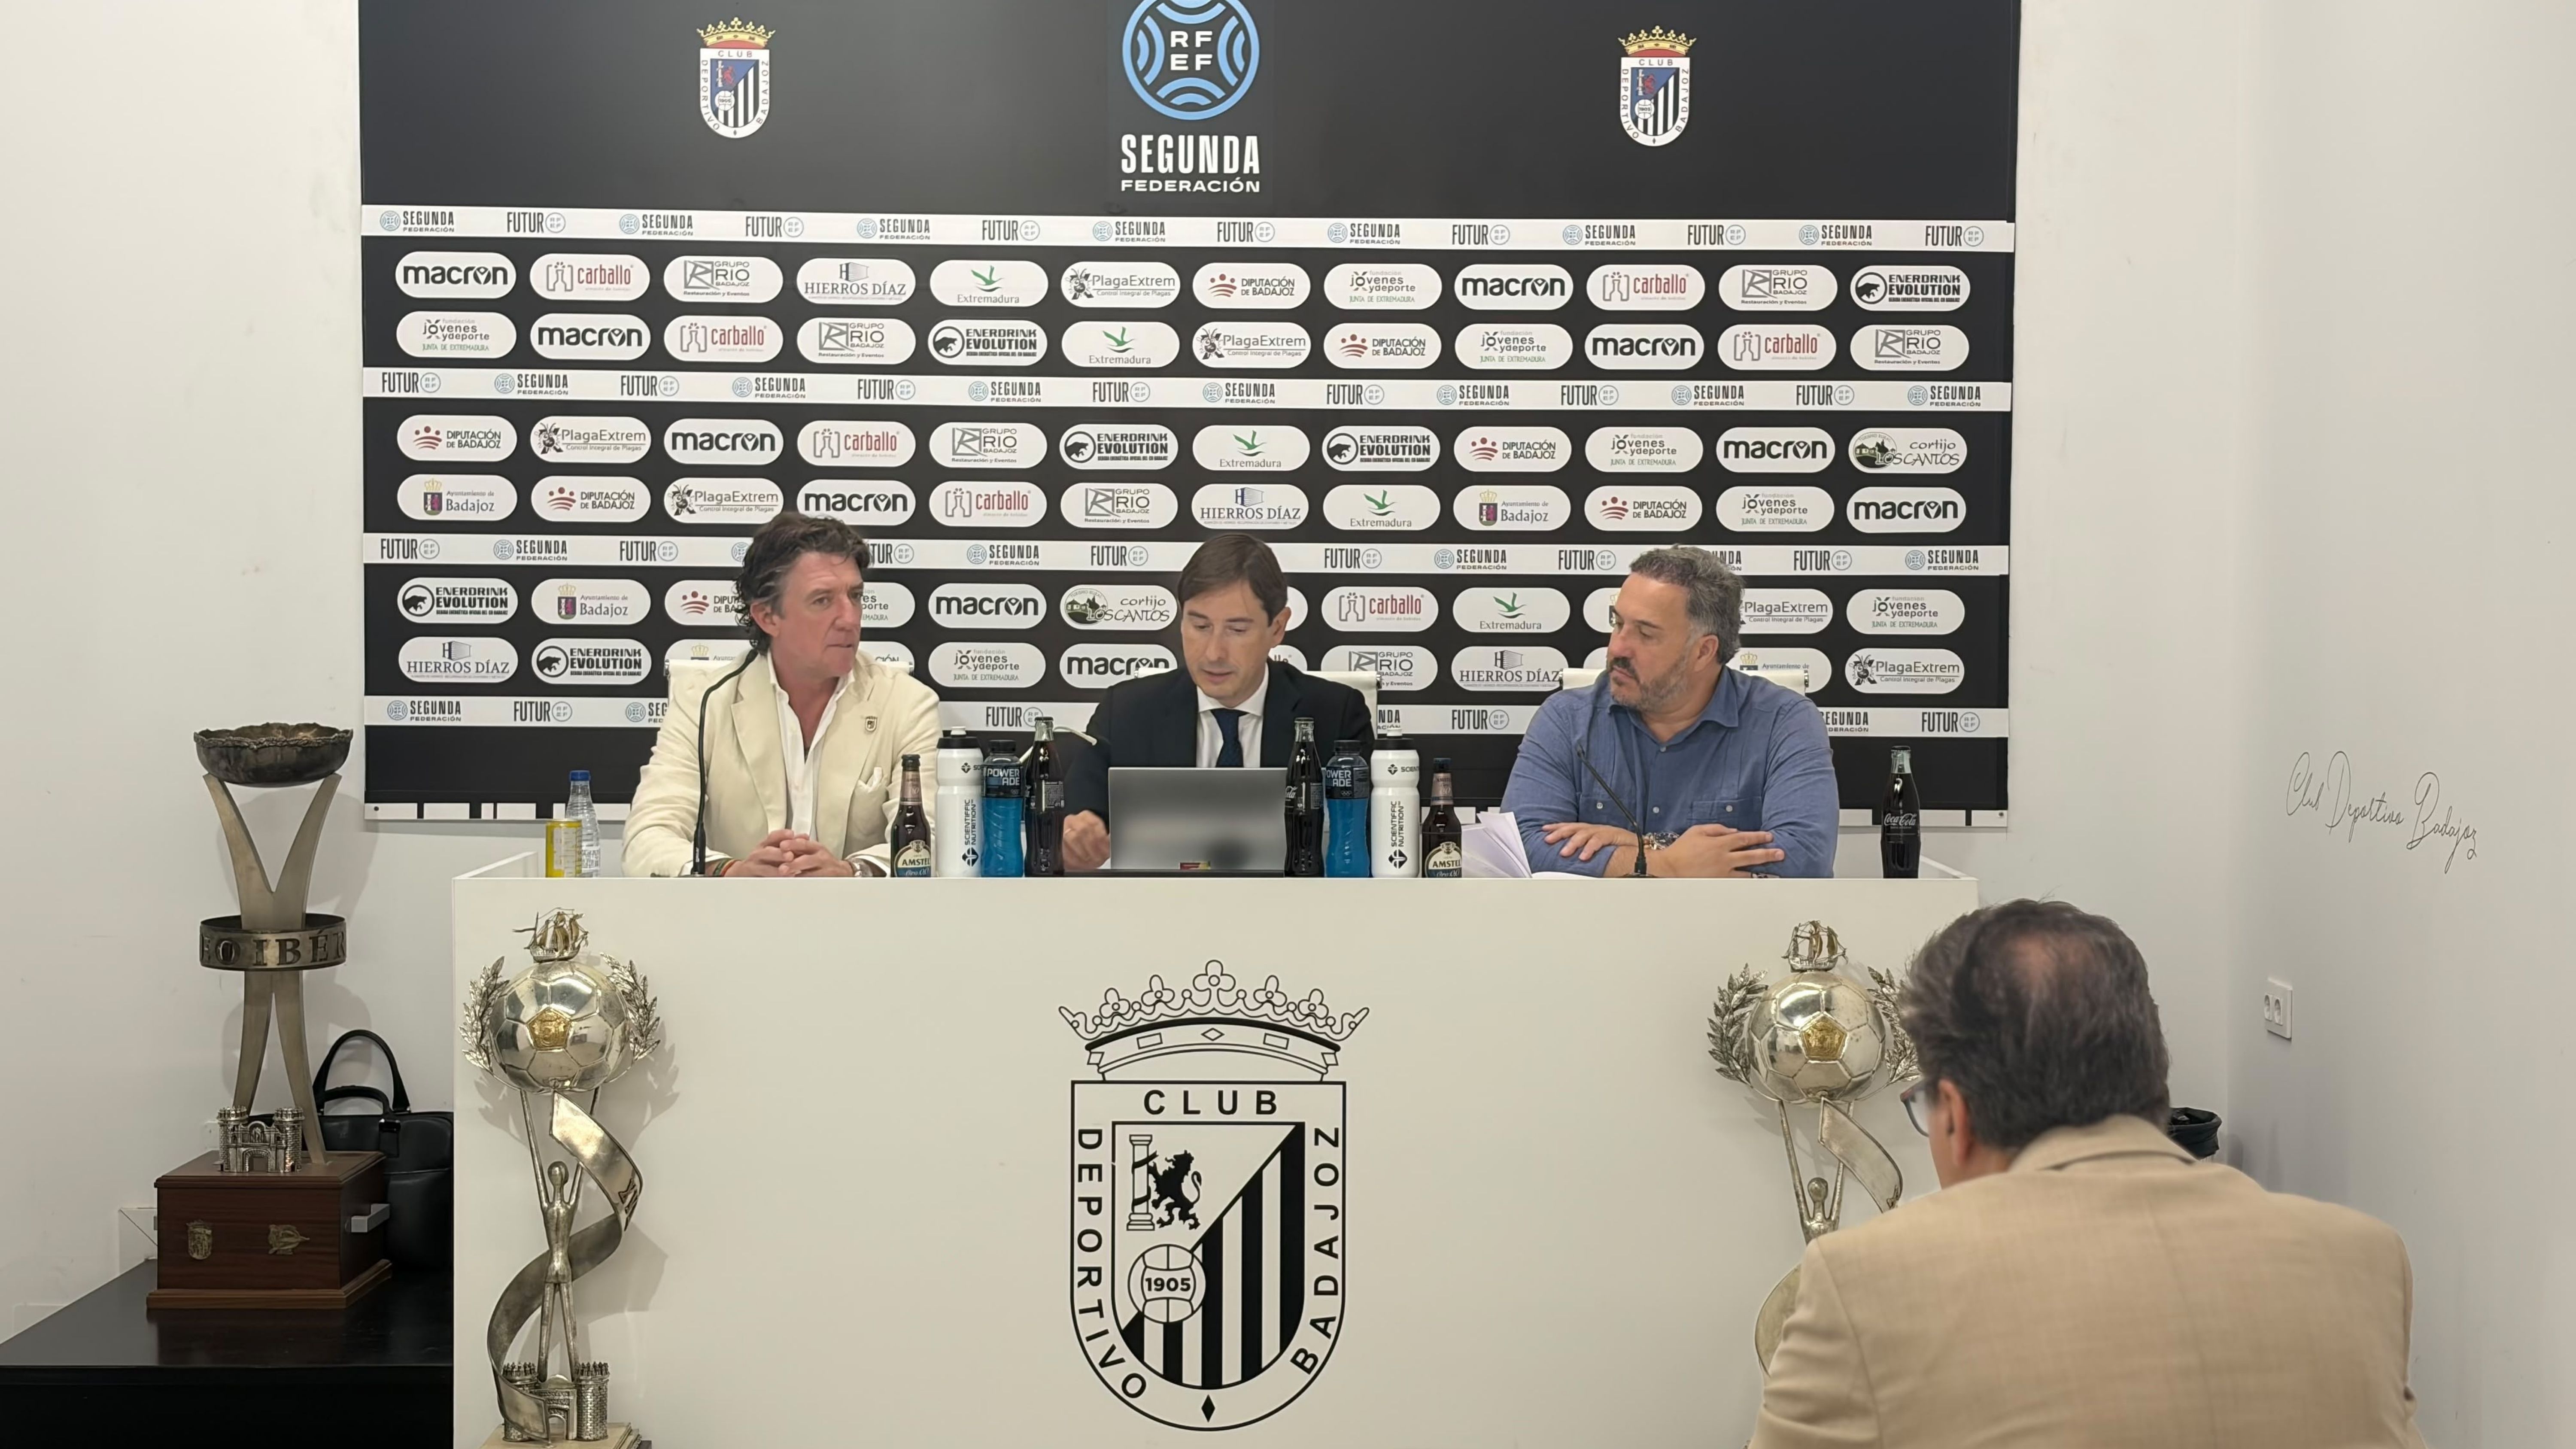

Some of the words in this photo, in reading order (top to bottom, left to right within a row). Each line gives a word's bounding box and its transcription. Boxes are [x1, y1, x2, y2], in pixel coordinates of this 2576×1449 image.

[702, 60, 720, 130] DEPORTIVO
[756, 61, 769, 125] BADAJOZ
[1622, 69, 1639, 138] DEPORTIVO
[1675, 69, 1689, 132] BADAJOZ
[1121, 134, 1260, 174] SEGUNDA
[1121, 177, 1260, 192] FEDERACIÓN
[403, 211, 454, 225] SEGUNDA
[642, 214, 693, 229] SEGUNDA
[880, 219, 930, 233] SEGUNDA
[1350, 223, 1400, 237] SEGUNDA
[1822, 225, 1871, 239] SEGUNDA
[404, 266, 507, 285] macron
[1091, 274, 1176, 289] PlagaExtrem
[1242, 276, 1294, 288] DIPUTACIÓN
[1889, 275, 1960, 283] ENERDRINK
[805, 283, 868, 295] HIERROS
[872, 281, 906, 295] DÍAZ
[1462, 278, 1565, 296] macron
[1774, 277, 1807, 289] RIO
[1889, 284, 1960, 295] EVOLUTION
[1252, 286, 1294, 296] BADAJOZ
[957, 294, 1019, 303] Extremadura
[538, 327, 642, 346] macron
[966, 329, 1036, 337] ENERDRINK
[966, 338, 1036, 350] EVOLUTION
[1373, 336, 1425, 349] DIPUTACIÓN
[1592, 337, 1695, 356] macron
[1383, 346, 1425, 356] BADAJOZ
[517, 374, 568, 388] SEGUNDA
[991, 382, 1041, 395] SEGUNDA
[1930, 386, 1981, 400] SEGUNDA
[447, 429, 501, 440] DIPUTACIÓN
[672, 432, 775, 451] macron
[1097, 433, 1167, 441] ENERDRINK
[458, 438, 501, 449] BADAJOZ
[983, 436, 1017, 448] RIO
[1097, 443, 1168, 454] EVOLUTION
[1910, 439, 1956, 453] cortijo
[1724, 441, 1827, 459] macron
[1220, 459, 1281, 467] Extremadura
[447, 498, 495, 513] Badajoz
[805, 493, 907, 512] macron
[1200, 507, 1263, 519] HIERROS
[1267, 506, 1300, 519] DÍAZ
[1501, 509, 1548, 523] Badajoz
[1854, 501, 1958, 519] macron
[1351, 518, 1412, 527] Extremadura
[516, 540, 567, 554] SEGUNDA
[1457, 549, 1506, 563] SEGUNDA
[1928, 550, 1978, 564] SEGUNDA
[436, 587, 507, 595] ENERDRINK
[436, 597, 507, 608] EVOLUTION
[936, 597, 1038, 615] macron
[1745, 601, 1828, 615] PlagaExtrem
[1480, 621, 1541, 629] Extremadura
[407, 661, 471, 673] HIERROS
[475, 659, 509, 673] DÍAZ
[410, 701, 461, 715] SEGUNDA
[987, 768, 1020, 777] POWER
[1327, 770, 1352, 779] OWER
[1002, 777, 1020, 786] ADE
[1332, 779, 1352, 787] ADE
[2286, 751, 2324, 816] Club
[2325, 750, 2404, 843] Deportivo
[2406, 772, 2477, 874] Badajoz
[1143, 1089, 1278, 1115] CLUB
[1290, 1127, 1340, 1375] BADAJOZ
[1077, 1129, 1147, 1400] DEPORTIVO
[1145, 1277, 1191, 1292] 1905
